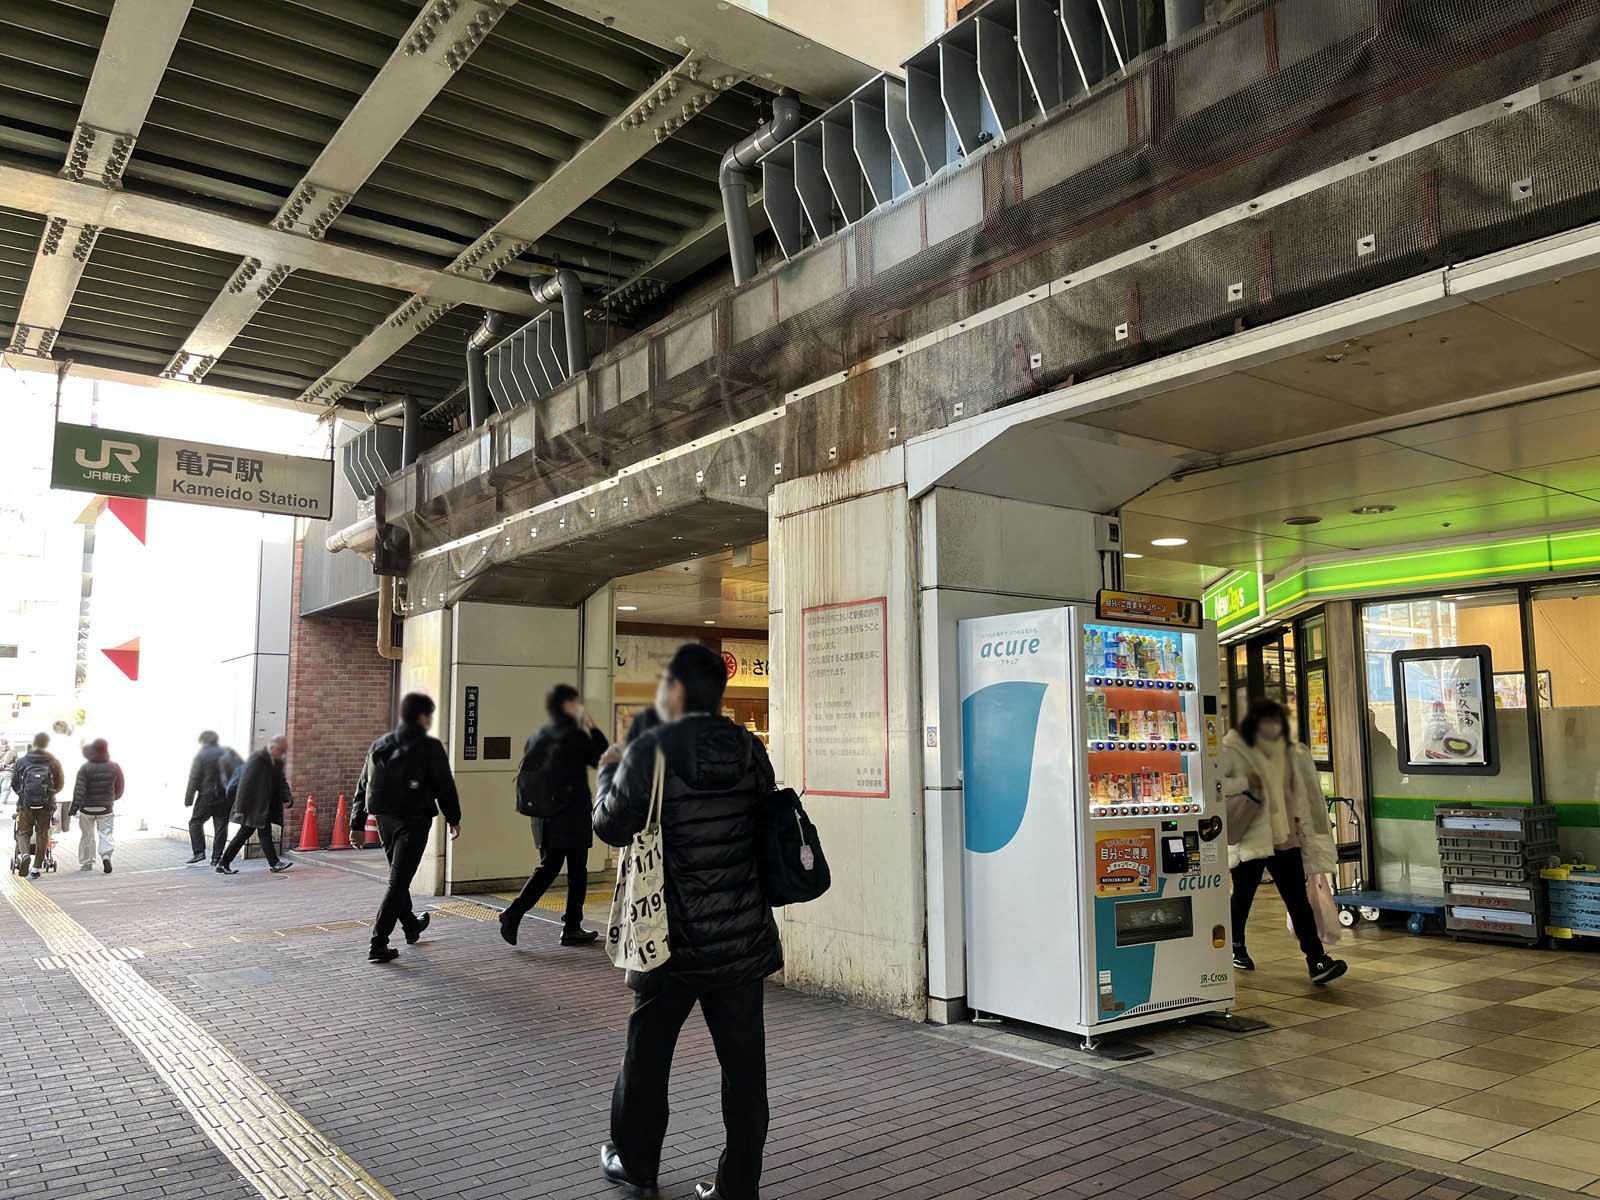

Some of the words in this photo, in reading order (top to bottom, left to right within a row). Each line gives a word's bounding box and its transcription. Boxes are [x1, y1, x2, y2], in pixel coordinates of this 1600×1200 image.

[75, 439, 141, 474] JR
[175, 449, 264, 483] 亀戸駅
[83, 470, 132, 484] JR東日本
[172, 479, 253, 501] Kameido
[258, 490, 319, 510] Station
[1215, 587, 1244, 619] NewDays
[980, 638, 1040, 658] acure
[1178, 873, 1221, 891] acure
[1200, 972, 1228, 985] JR-Cross
